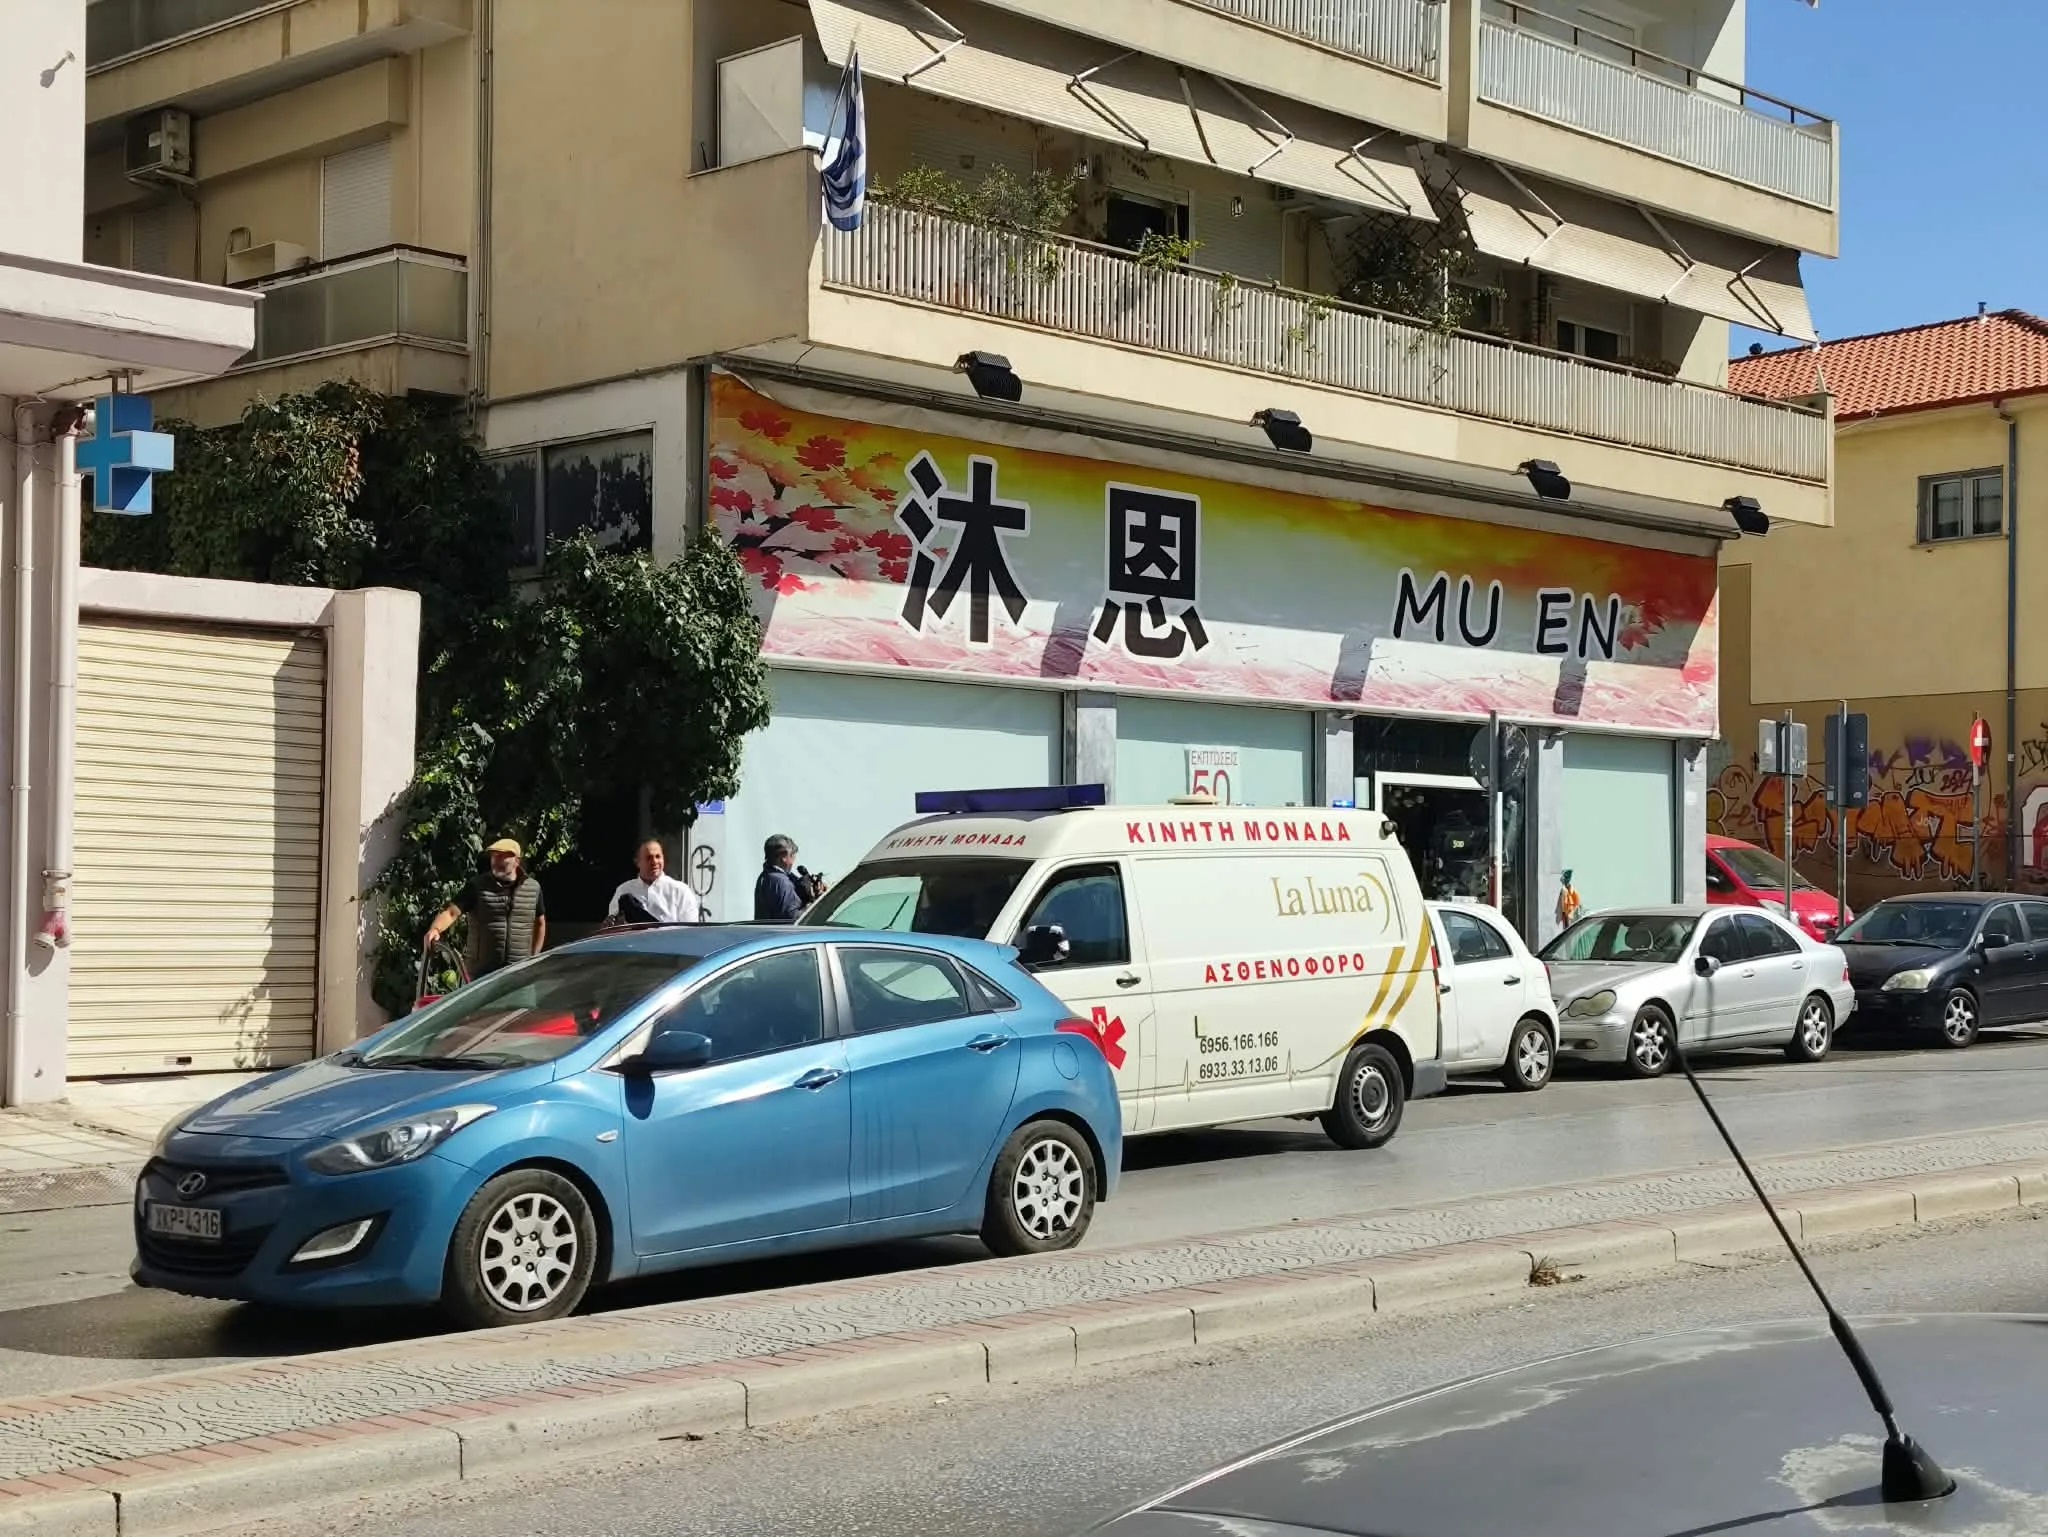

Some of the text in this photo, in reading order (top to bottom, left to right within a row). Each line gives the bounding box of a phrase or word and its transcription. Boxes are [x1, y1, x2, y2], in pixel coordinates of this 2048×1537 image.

[899, 456, 1210, 660] 沐恩
[1393, 573, 1618, 660] MU EN
[886, 833, 1027, 850] ΚΙΝΗΤΗ ΜΟΝΑΔΑ
[1126, 821, 1351, 843] ΚΙΝΗΤΗ ΜΟΝΑΔΑ
[1205, 953, 1365, 983] ΑΣΘΕΝΟΦΟΡΟ
[1199, 1031, 1279, 1054] 6956.166.166
[1199, 1056, 1278, 1079] 6933.33.13.06
